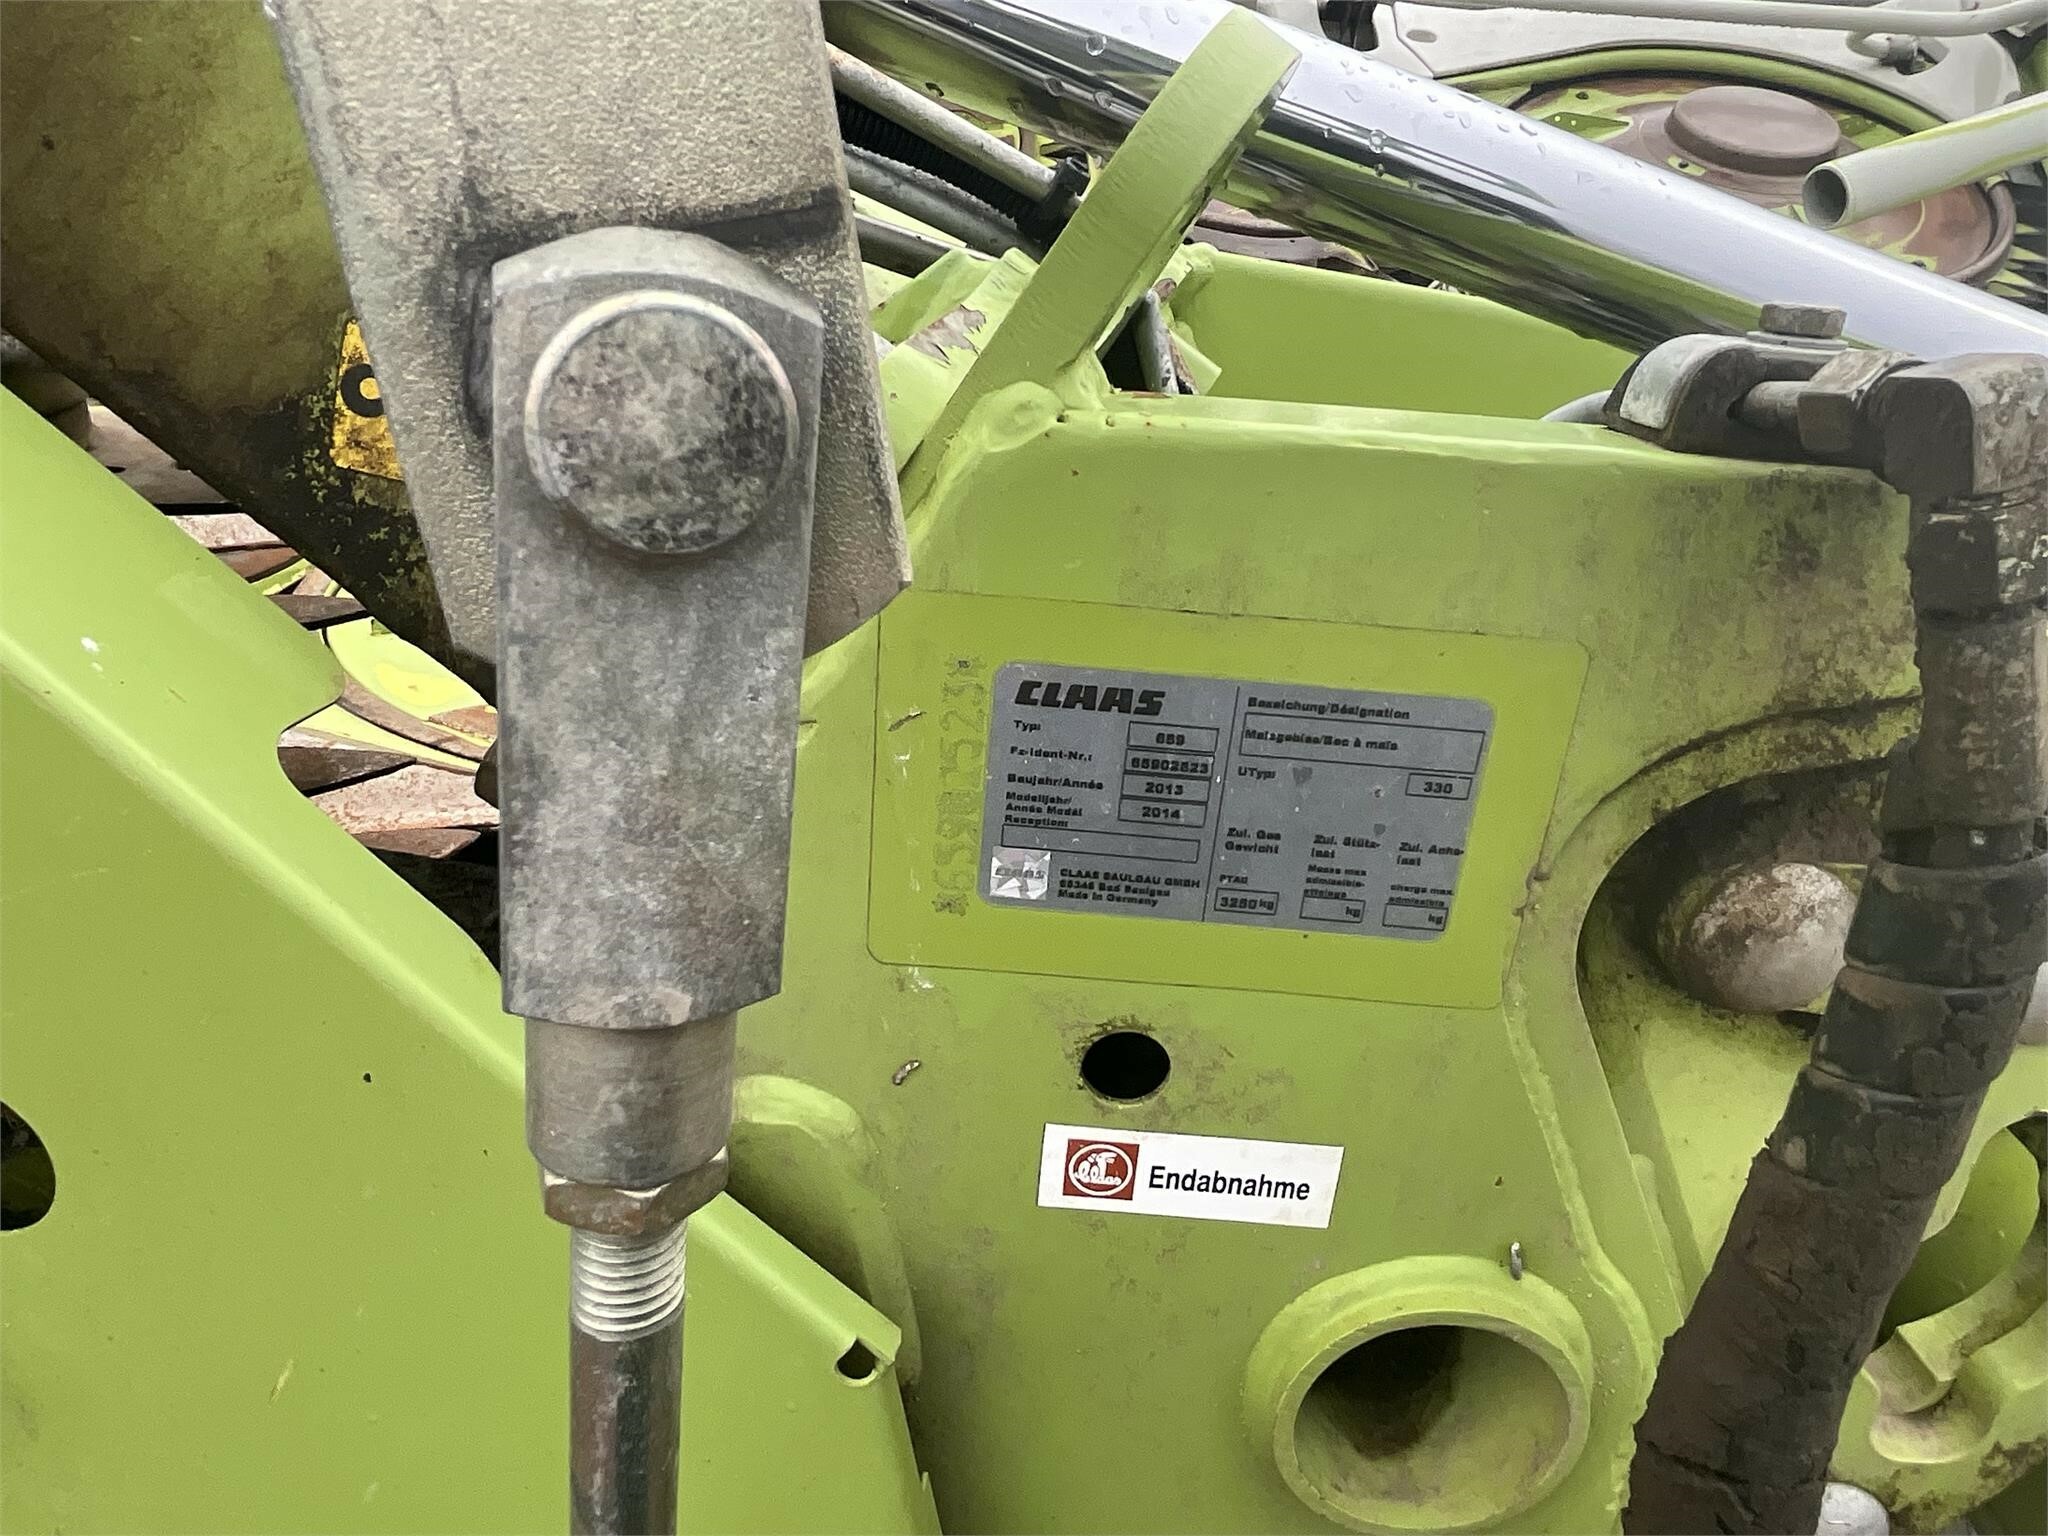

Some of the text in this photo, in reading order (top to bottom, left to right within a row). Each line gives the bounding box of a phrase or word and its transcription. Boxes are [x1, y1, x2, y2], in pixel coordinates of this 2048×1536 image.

[1014, 680, 1166, 716] CLAAS
[1013, 720, 1041, 733] Typ:
[1155, 732, 1186, 746] 659
[1007, 773, 1104, 790] Baujahr/Année
[1145, 781, 1184, 796] 2013
[1423, 781, 1453, 794] 330
[1142, 806, 1181, 820] 2014
[1060, 868, 1099, 879] CLAAS
[1149, 1165, 1310, 1201] Endabnahme
